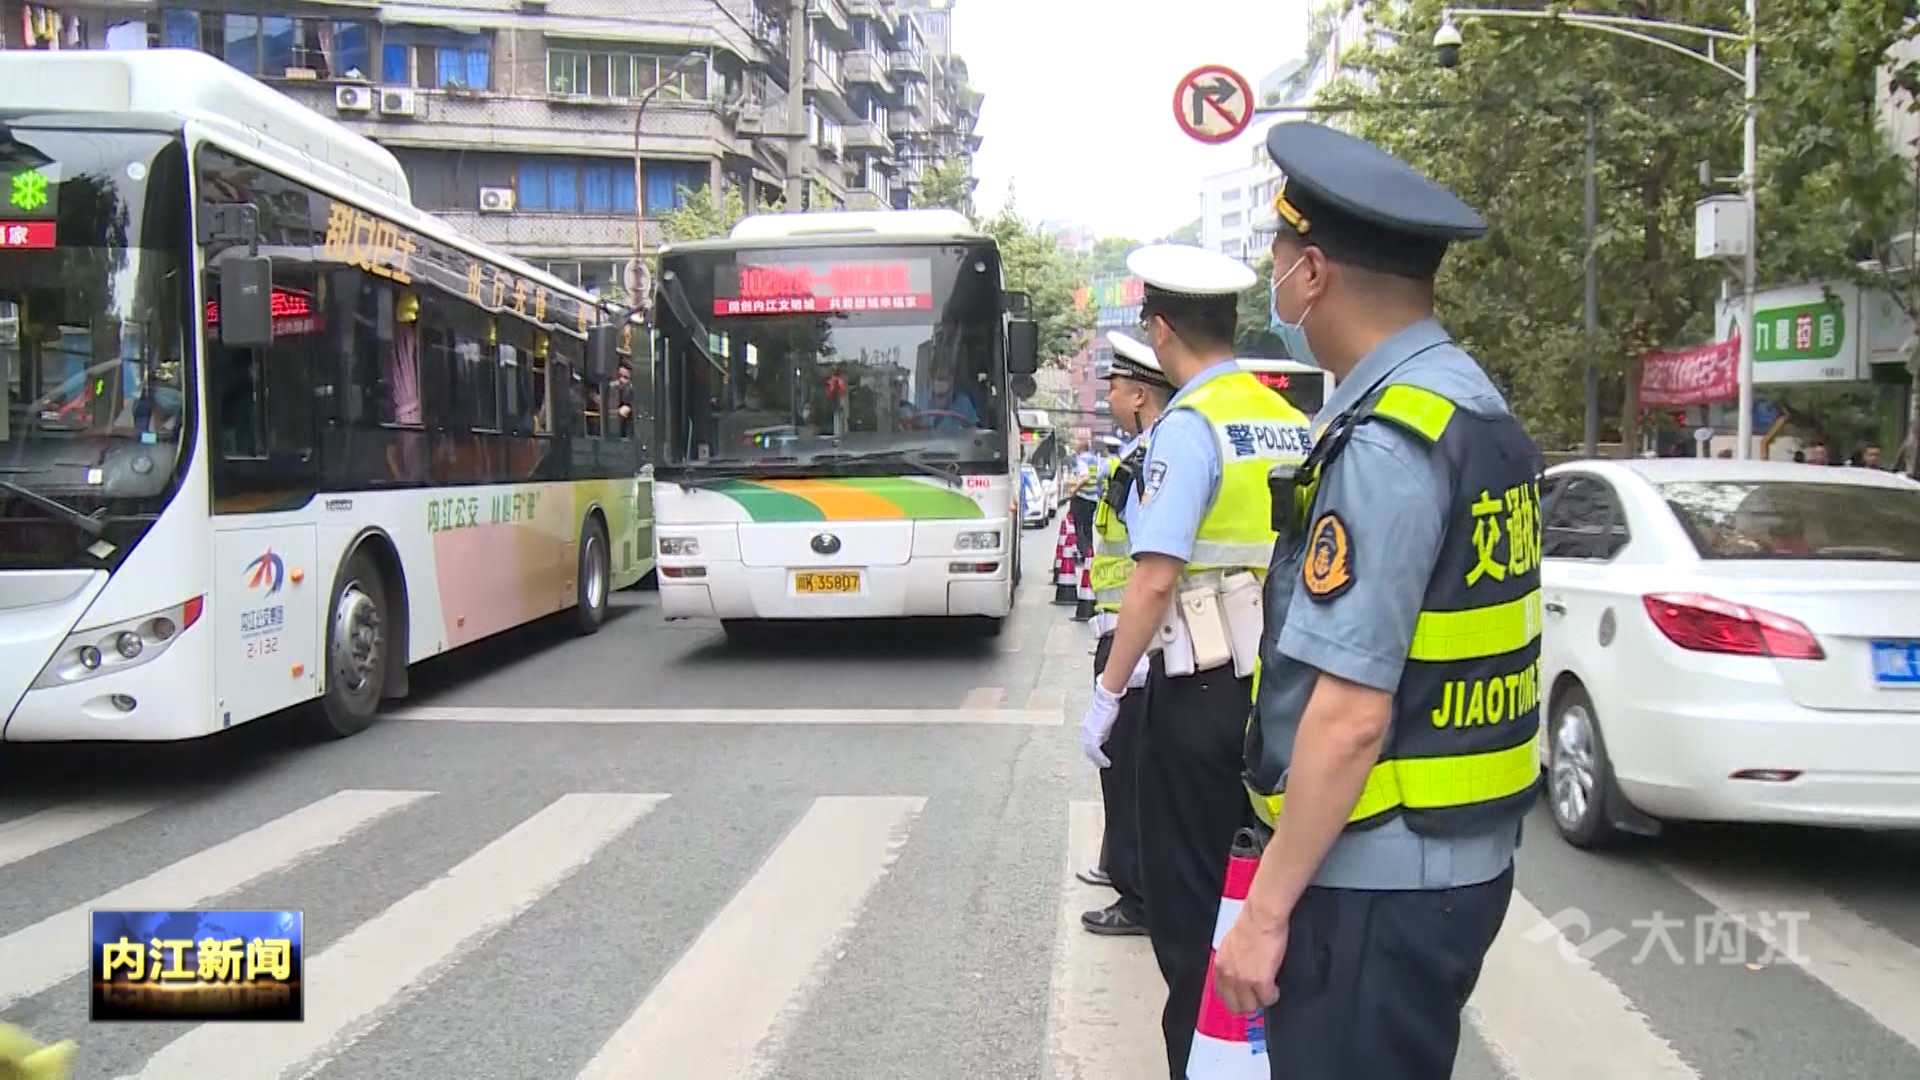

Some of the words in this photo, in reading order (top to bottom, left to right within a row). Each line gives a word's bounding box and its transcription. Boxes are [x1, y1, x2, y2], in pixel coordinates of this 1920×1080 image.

[1226, 423, 1256, 457] 警
[1254, 427, 1298, 450] POLICE
[427, 496, 479, 534] 内江公交
[1466, 482, 1541, 587] 交通执
